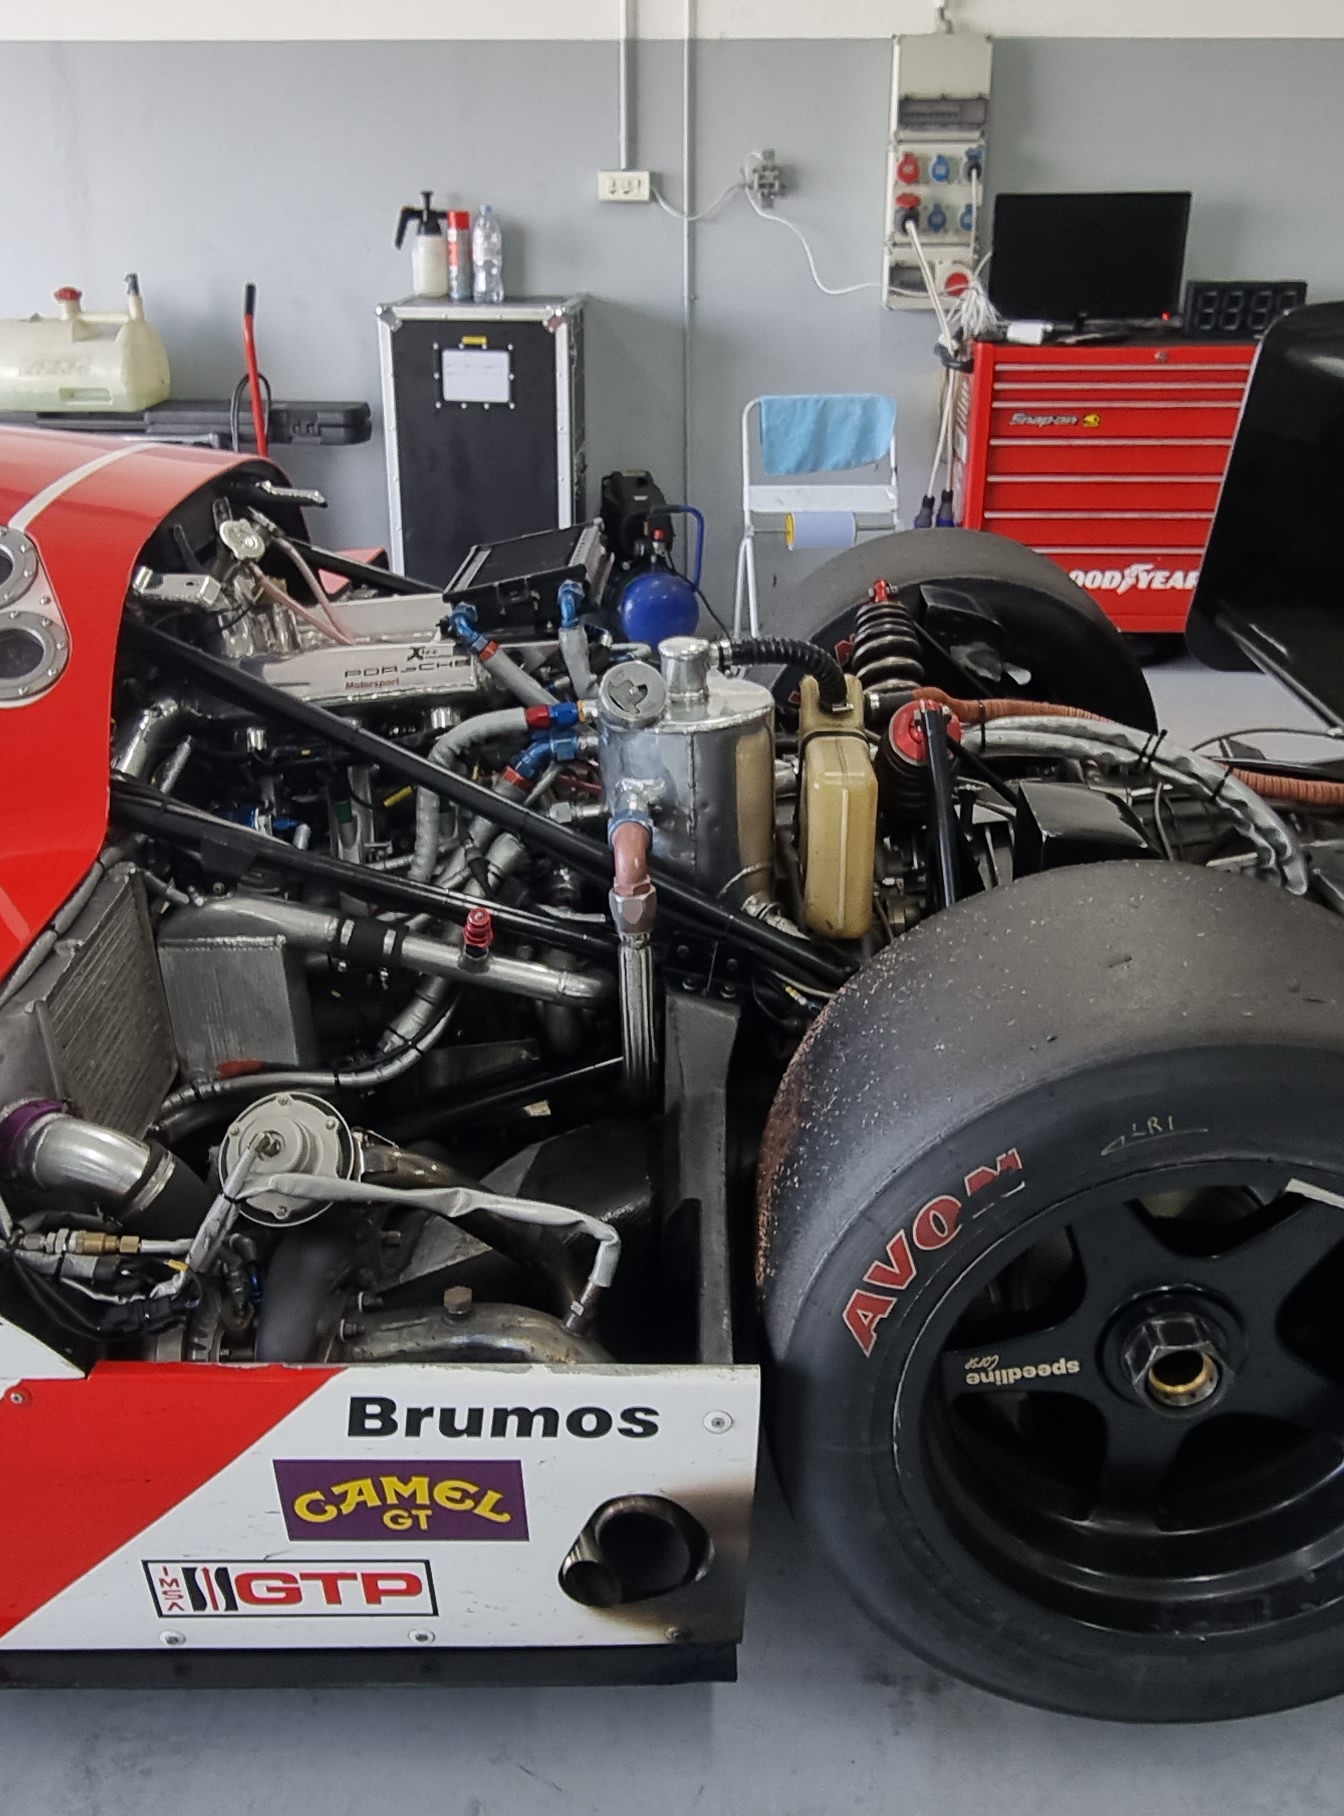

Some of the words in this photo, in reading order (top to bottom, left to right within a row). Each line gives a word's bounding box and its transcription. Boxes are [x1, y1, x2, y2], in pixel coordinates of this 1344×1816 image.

[1008, 411, 1079, 428] Snap-on
[345, 678, 400, 691] Motorsport
[965, 1357, 1081, 1386] speedline
[347, 1396, 660, 1439] Brumos
[293, 1475, 513, 1524] CAMEL
[381, 1508, 434, 1531] GT
[233, 1571, 423, 1606] GTP
